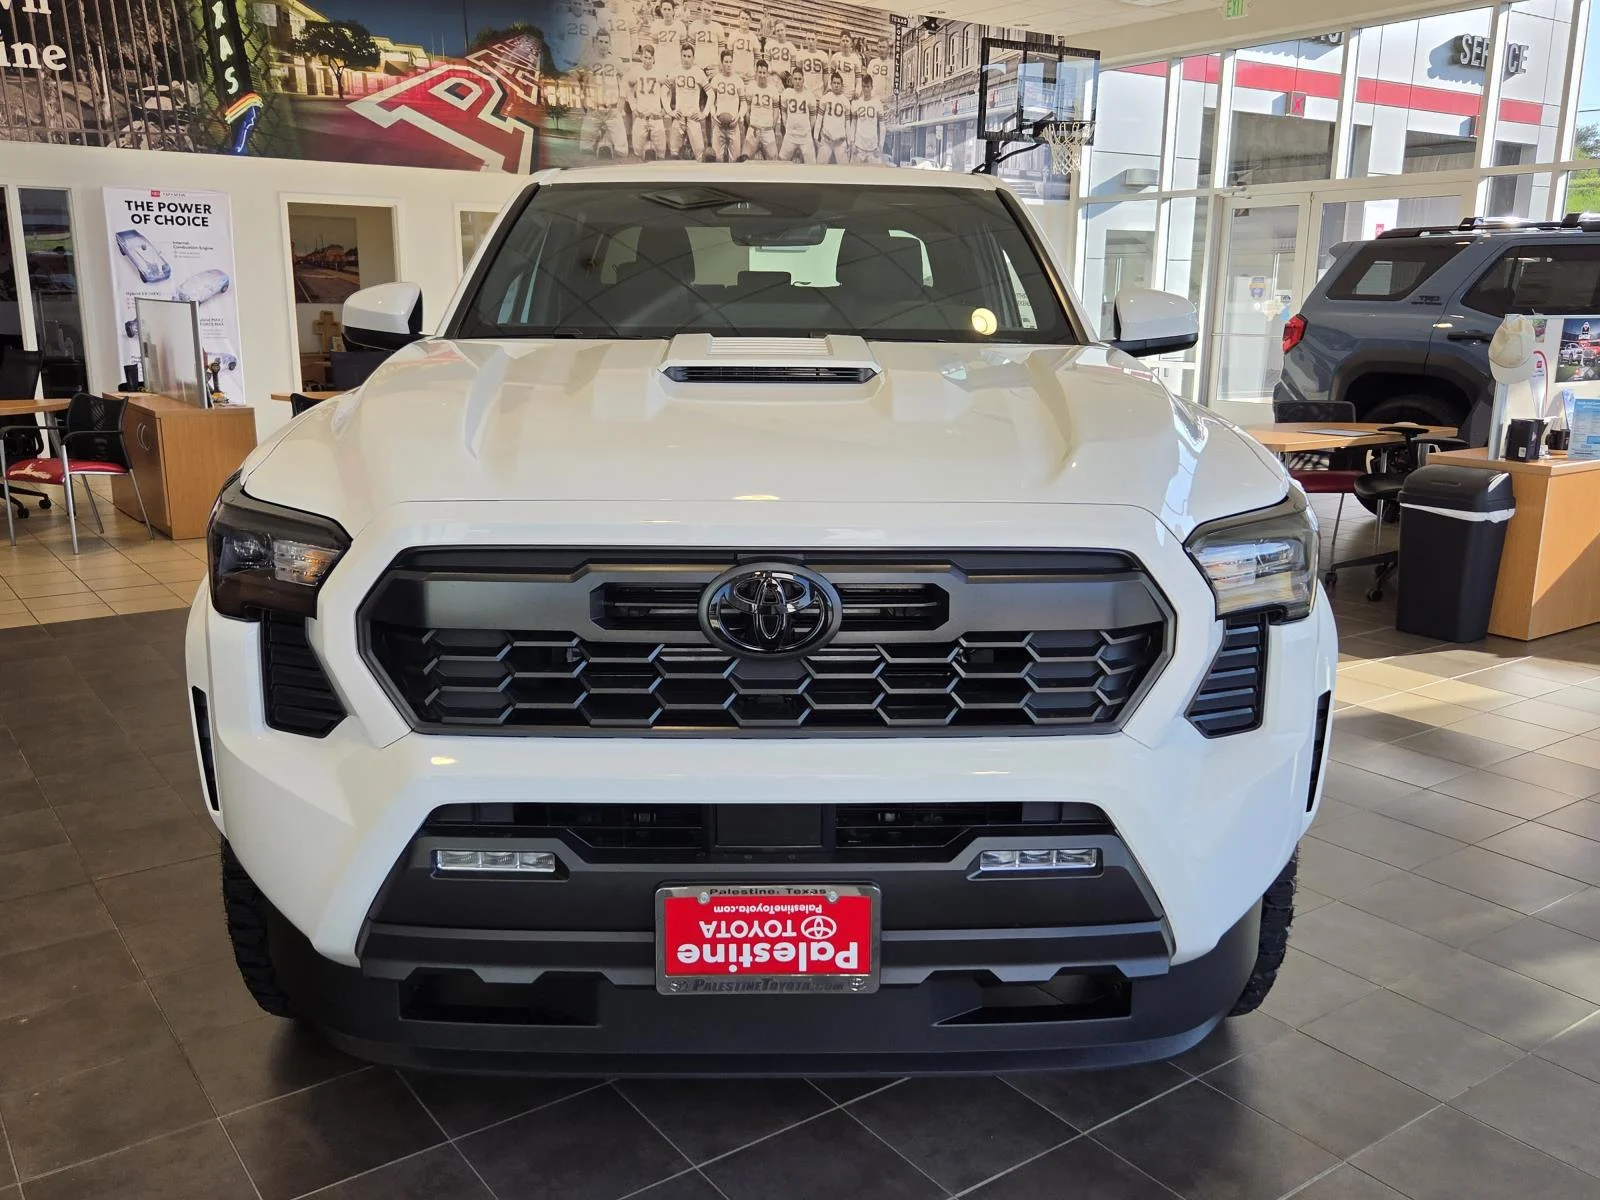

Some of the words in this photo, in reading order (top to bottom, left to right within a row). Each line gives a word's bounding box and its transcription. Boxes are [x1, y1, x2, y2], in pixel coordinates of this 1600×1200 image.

[1227, 0, 1243, 17] EXIT
[608, 19, 627, 32] 12
[658, 30, 677, 43] 27
[697, 30, 713, 43] 21
[736, 38, 751, 51] 31
[771, 47, 790, 62] 28
[1460, 33, 1529, 75] SECE
[592, 63, 615, 77] 22
[803, 58, 823, 73] 35
[838, 60, 852, 73] 15
[872, 64, 888, 77] 38
[639, 77, 657, 95] 17
[676, 75, 696, 89] 30
[717, 81, 736, 96] 33
[754, 94, 771, 107] 13
[788, 99, 807, 114] 34
[827, 102, 844, 117] 10
[858, 106, 875, 119] 20
[124, 200, 154, 212] THE
[157, 202, 212, 215] POWER
[130, 213, 151, 225] OF
[154, 214, 209, 227] CHOICE
[785, 887, 827, 895] Texas
[713, 902, 823, 914] PalestineToyota.com
[698, 919, 798, 939] TOYOTA
[676, 941, 859, 973] Palestine
